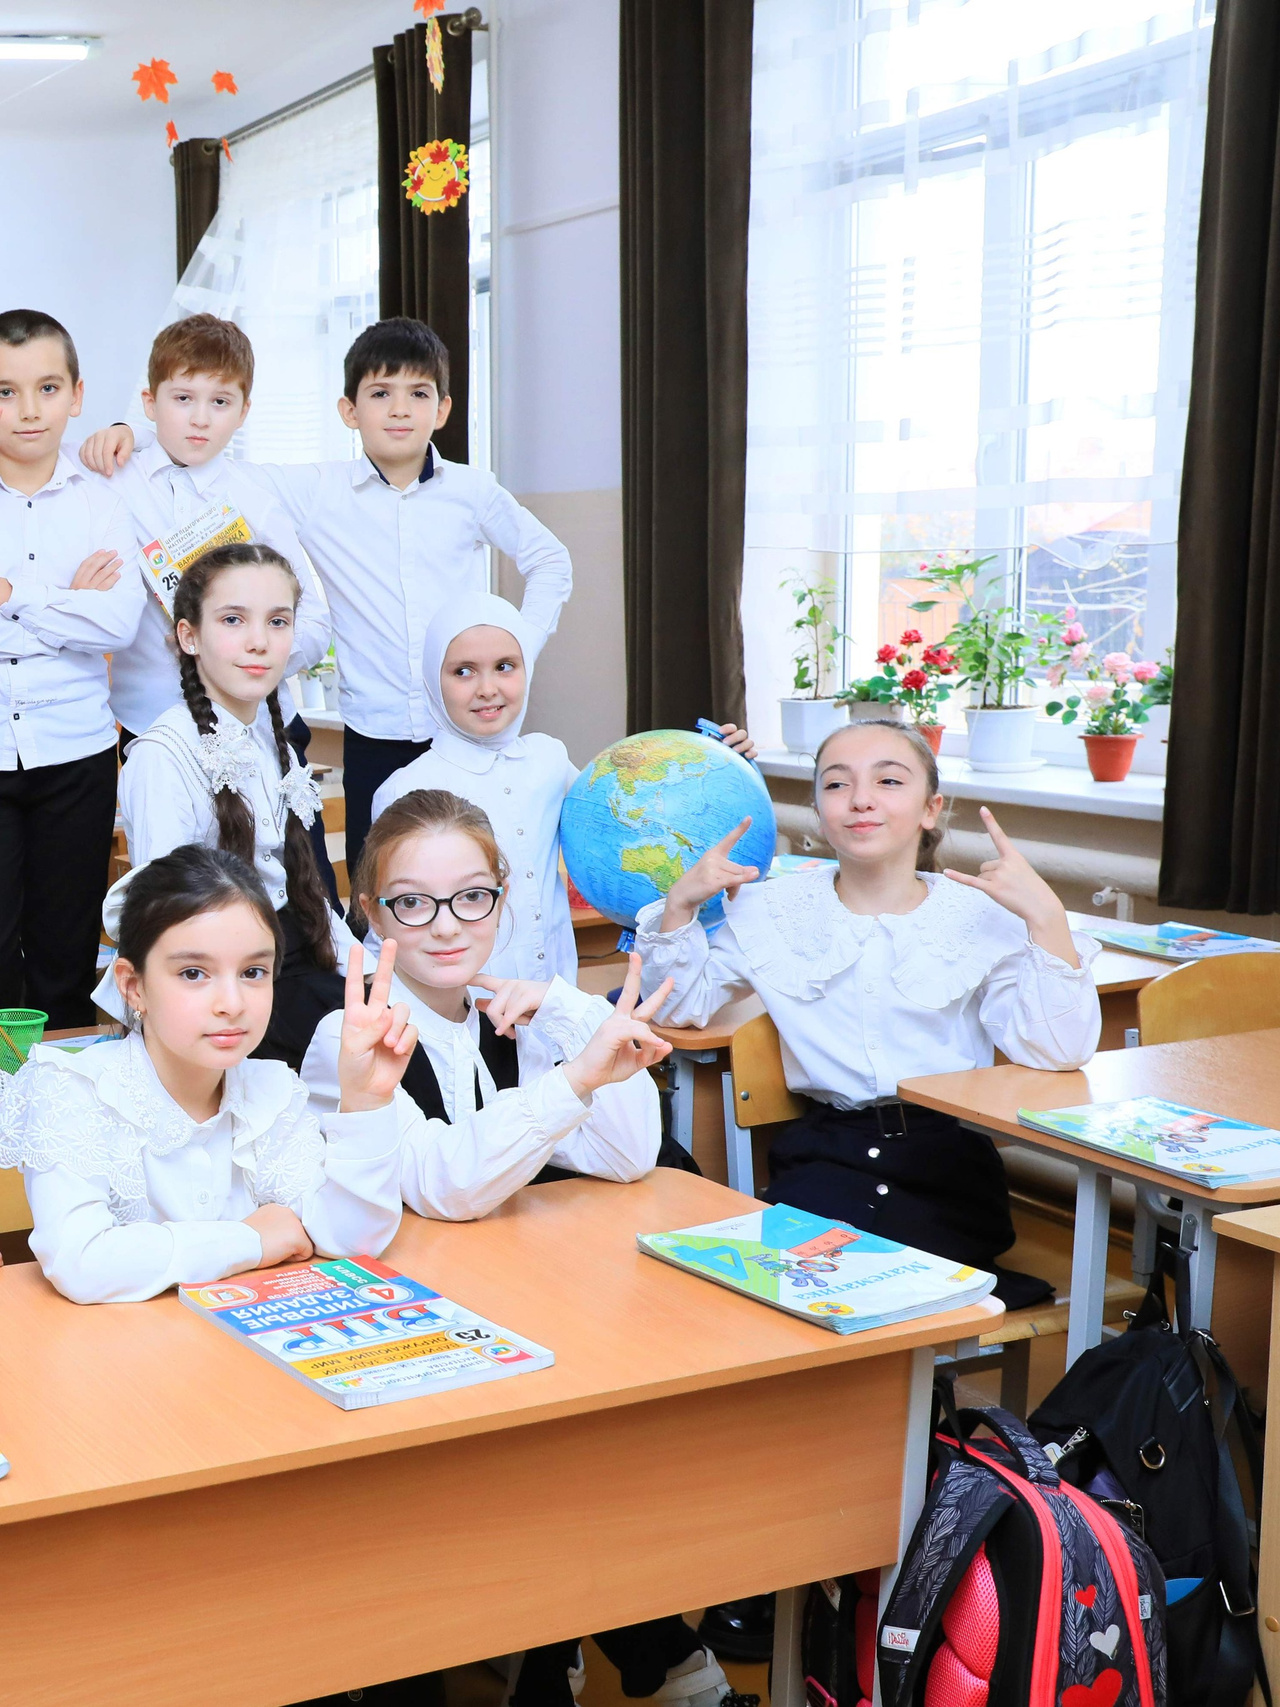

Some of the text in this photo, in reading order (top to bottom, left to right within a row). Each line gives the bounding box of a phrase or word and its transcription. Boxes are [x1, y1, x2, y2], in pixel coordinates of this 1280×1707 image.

[177, 538, 215, 569] ВАРИАНТОВ
[162, 571, 180, 591] 25
[667, 1244, 749, 1281] 4
[792, 1260, 934, 1300] Математика
[230, 1289, 352, 1319] ЗАДАНИЯ
[367, 1287, 395, 1301] 4
[241, 1298, 370, 1330] ТИПОВЫЕ
[283, 1303, 459, 1355] ВПР
[455, 1328, 491, 1342] 25
[345, 1336, 448, 1361] ОКРУЖАЮЩИЙ
[385, 1342, 460, 1362] ВАРИАНТОВ
[310, 1358, 341, 1369] МИР
[323, 1358, 380, 1376] ЗАДАНИЙ
